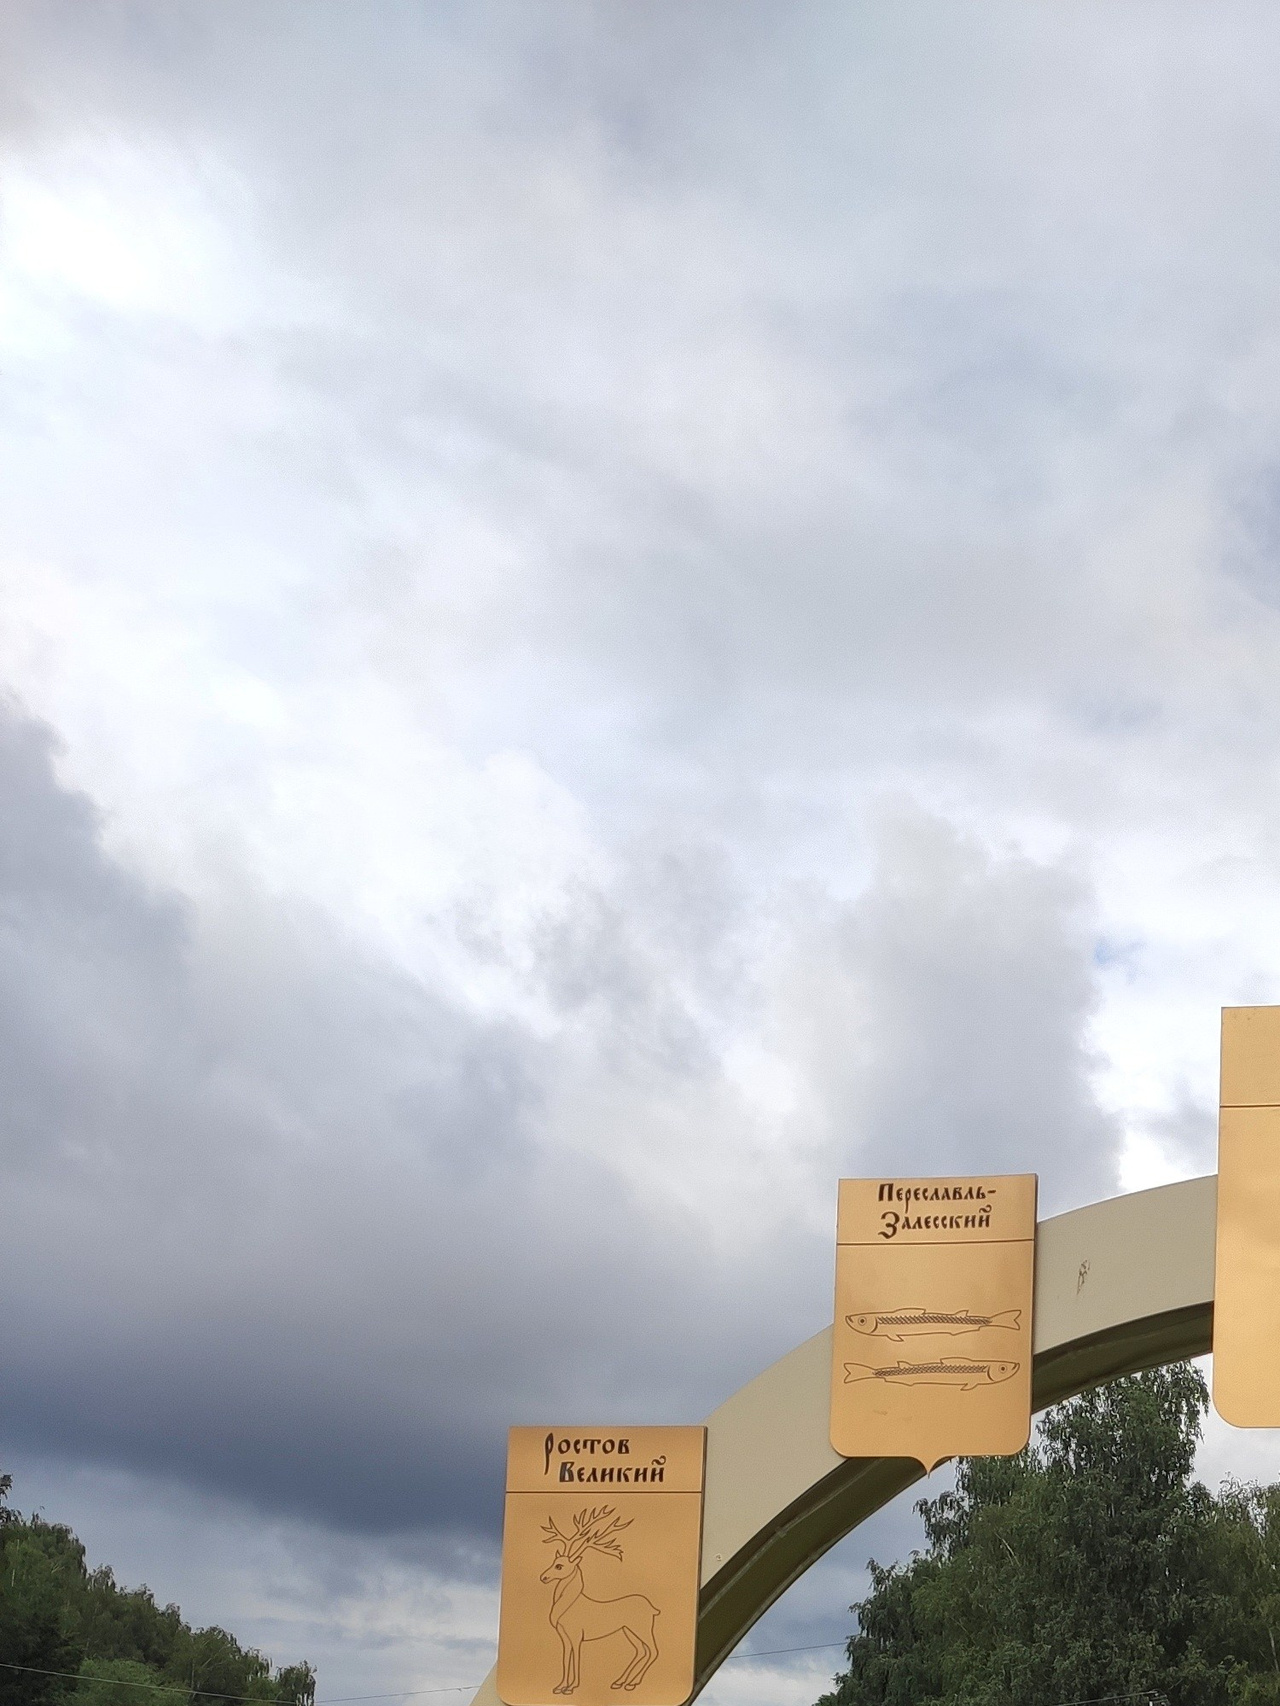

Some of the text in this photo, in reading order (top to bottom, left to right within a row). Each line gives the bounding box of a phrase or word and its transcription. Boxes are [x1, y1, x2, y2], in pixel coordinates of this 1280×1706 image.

[878, 1183, 996, 1213] Переславль-
[878, 1205, 992, 1239] Залесский
[544, 1432, 630, 1475] Ростов
[559, 1455, 666, 1483] Великий
